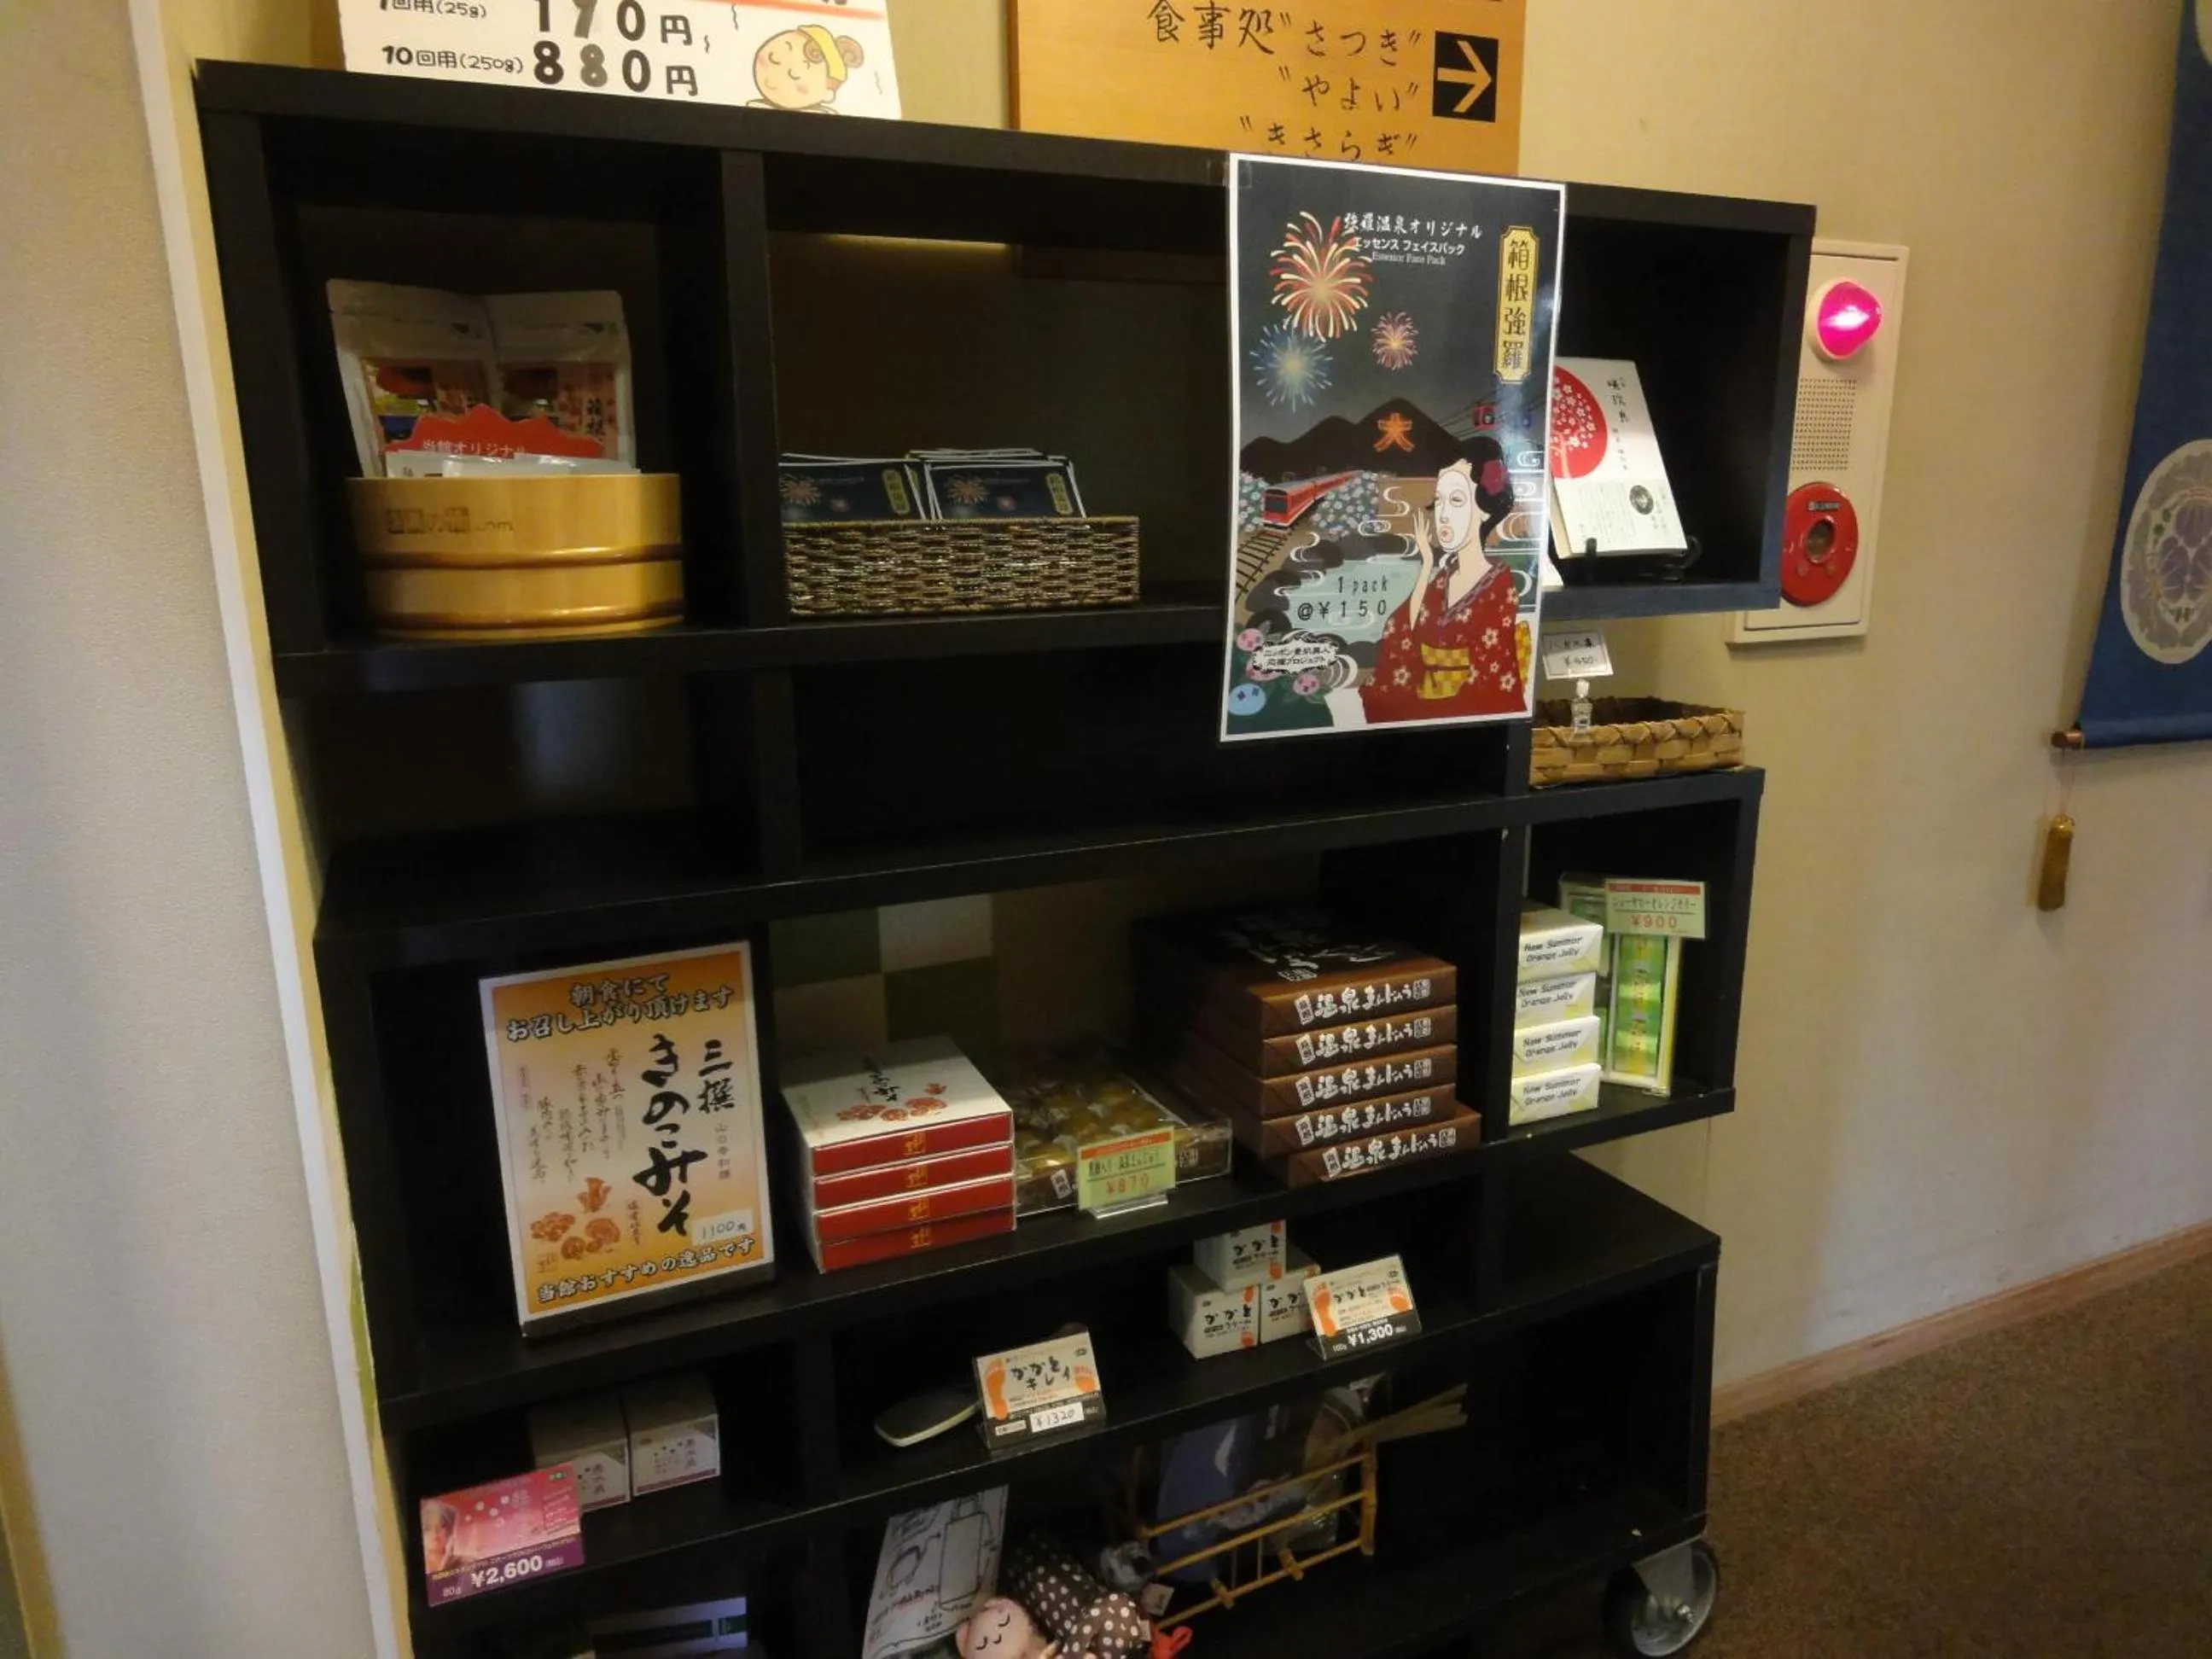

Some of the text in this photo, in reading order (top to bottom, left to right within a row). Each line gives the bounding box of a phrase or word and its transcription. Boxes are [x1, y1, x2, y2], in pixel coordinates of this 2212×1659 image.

[382, 40, 698, 96] 10回用(250g) 880円
[1503, 240, 1529, 370] 箱根強羅
[1351, 574, 1388, 596] pack
[1524, 943, 1543, 952] New
[1557, 947, 1580, 958] Jelly
[570, 974, 671, 1007] 朝食にて
[507, 985, 734, 1042] お召し上がり頂けます
[632, 1033, 708, 1237] きのこみそ
[536, 1237, 755, 1305] 当館おすすめの逸品です
[1348, 1324, 1394, 1347] ¥1,300
[470, 1555, 544, 1588] ¥2,600
